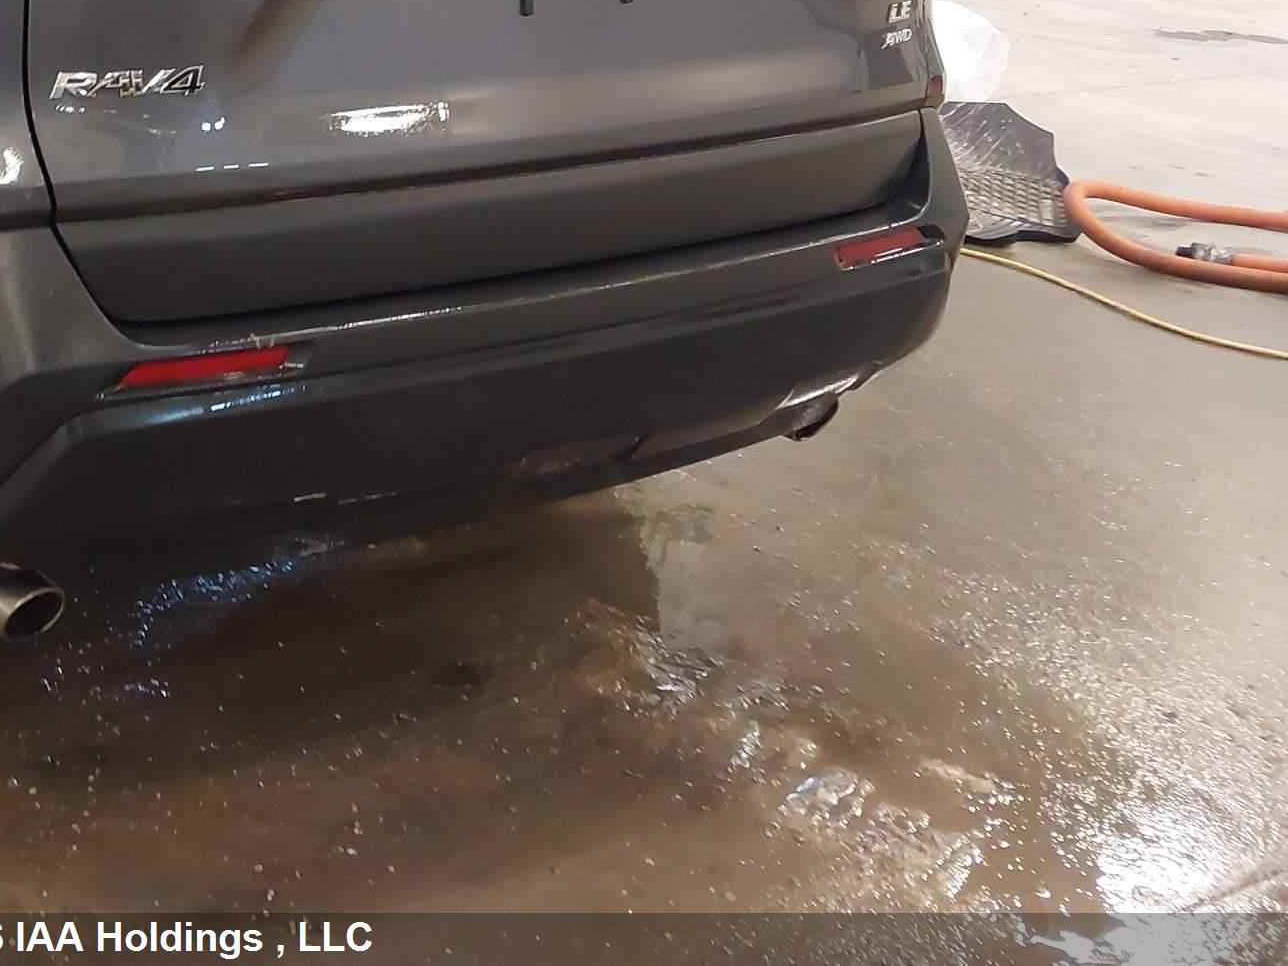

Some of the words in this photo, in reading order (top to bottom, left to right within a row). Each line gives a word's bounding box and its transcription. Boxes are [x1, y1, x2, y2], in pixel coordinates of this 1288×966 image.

[887, 0, 912, 24] LE
[881, 28, 912, 50] AWD
[49, 64, 206, 99] RAV4
